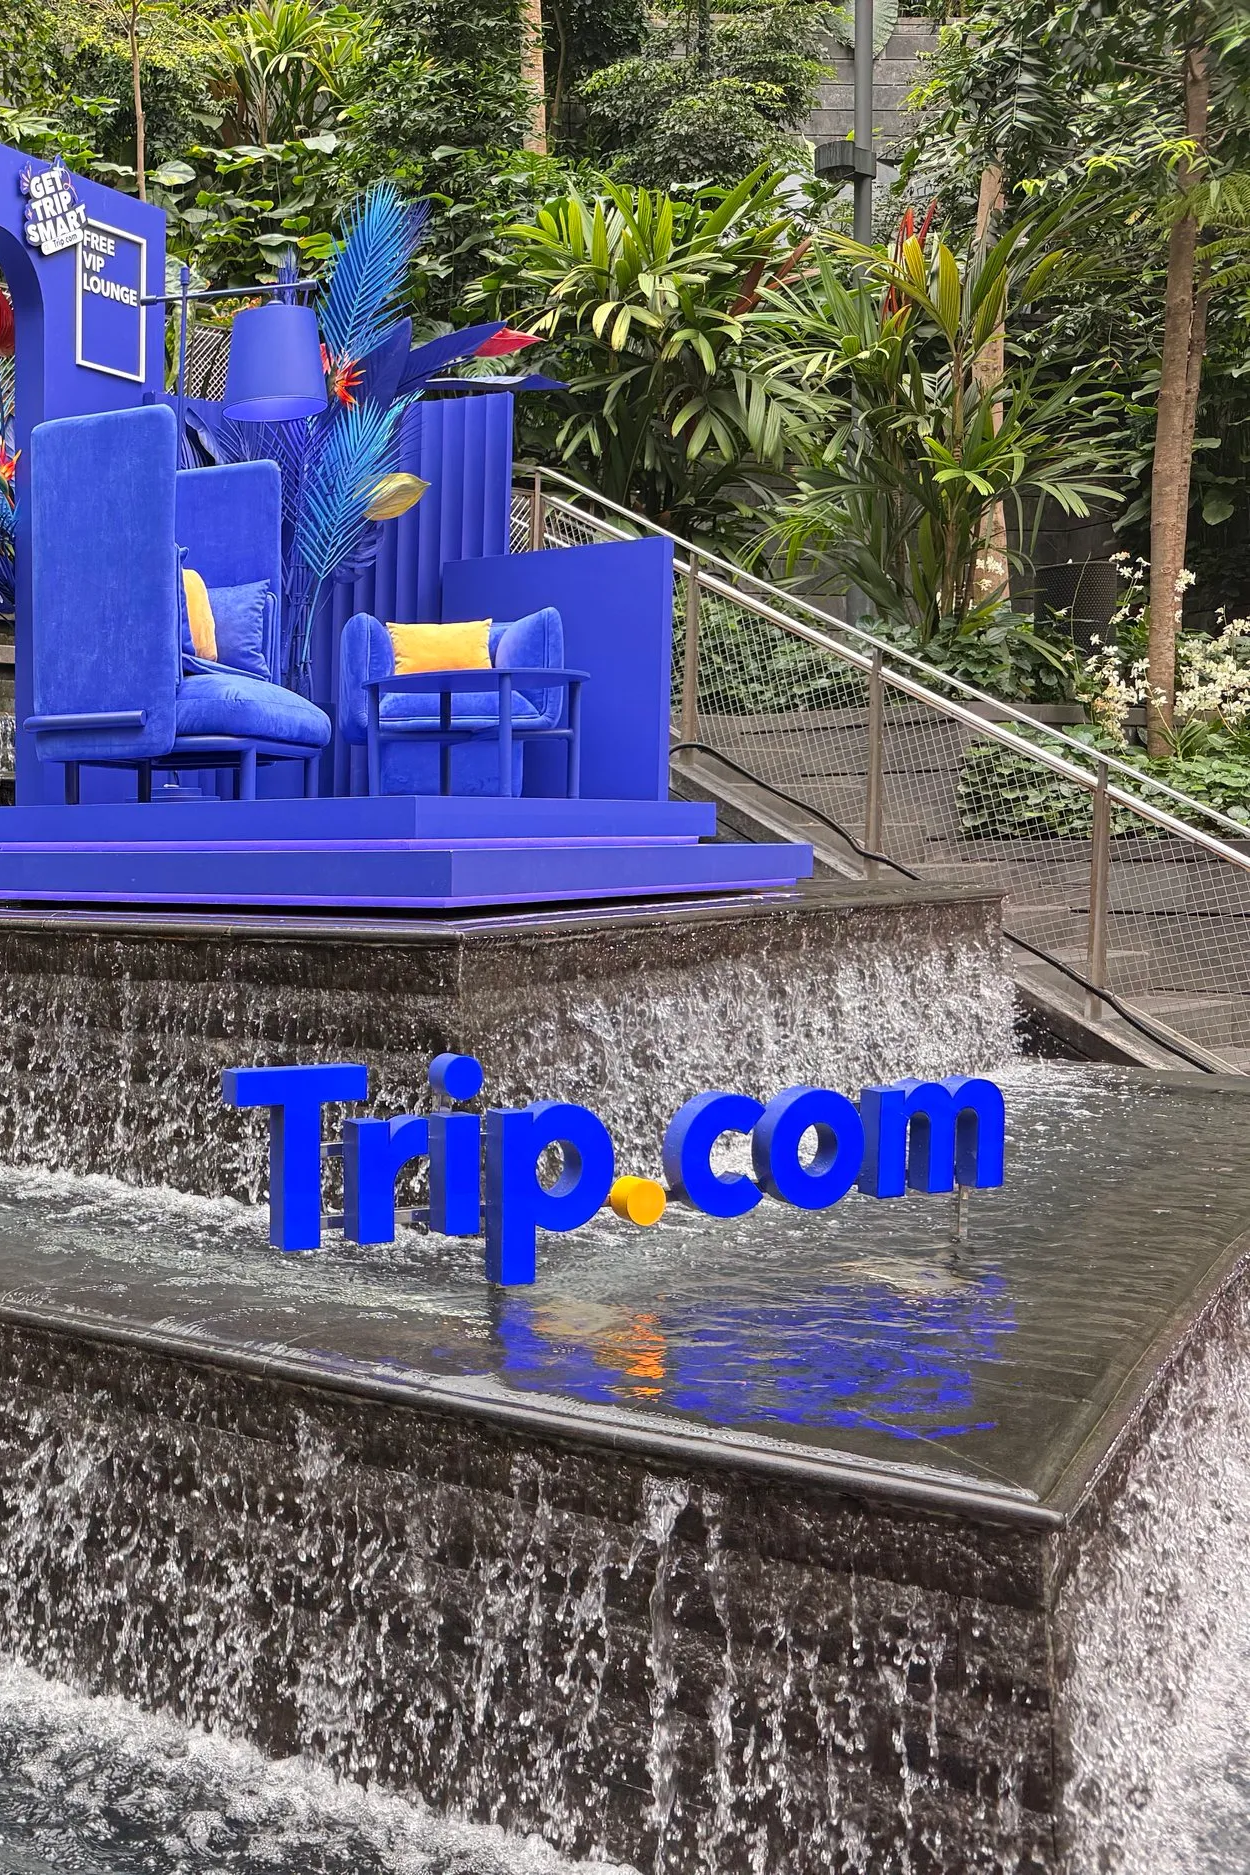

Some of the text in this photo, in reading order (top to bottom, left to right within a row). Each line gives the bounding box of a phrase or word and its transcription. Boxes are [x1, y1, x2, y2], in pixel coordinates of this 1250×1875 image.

[30, 171, 63, 199] GET
[31, 191, 71, 221] TRIP
[27, 204, 87, 244] SMART
[52, 234, 77, 248] Tripcom
[84, 231, 115, 257] FREE
[83, 251, 105, 272] VIP
[83, 275, 137, 307] LOUNGE
[222, 1053, 1005, 1286] Trip.com
